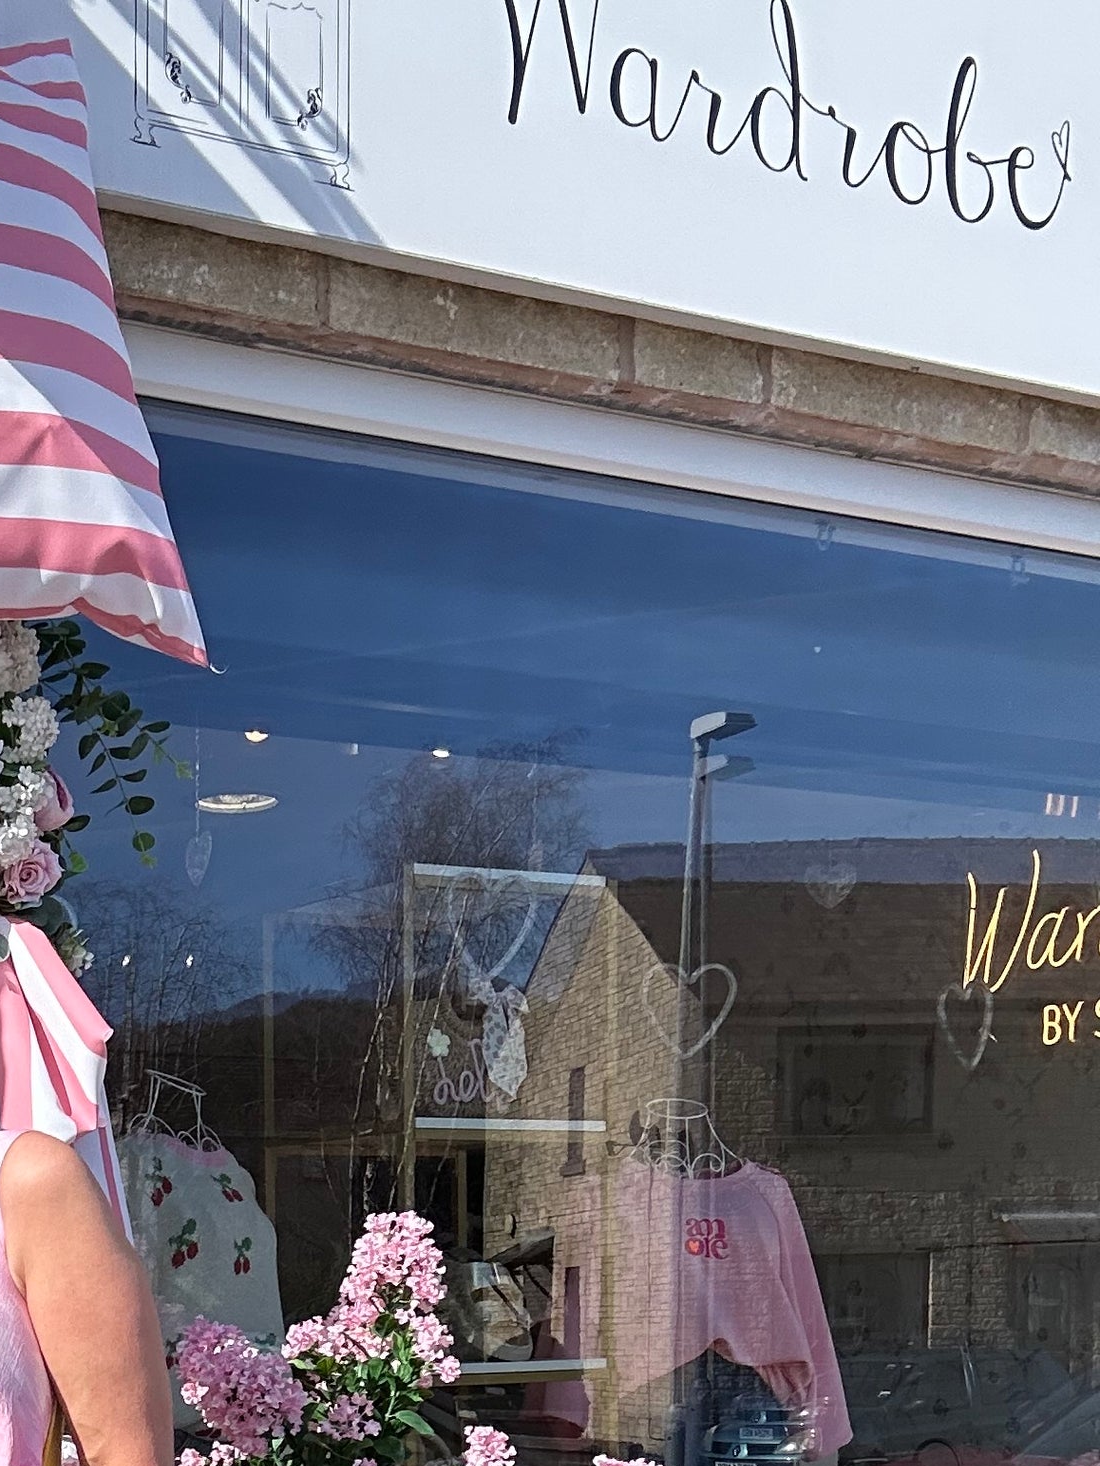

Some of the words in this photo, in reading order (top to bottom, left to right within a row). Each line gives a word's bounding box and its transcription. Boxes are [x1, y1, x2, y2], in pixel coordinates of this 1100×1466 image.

[502, 0, 1071, 231] Wardrobe
[962, 848, 1100, 993] War
[1042, 1000, 1085, 1046] BY
